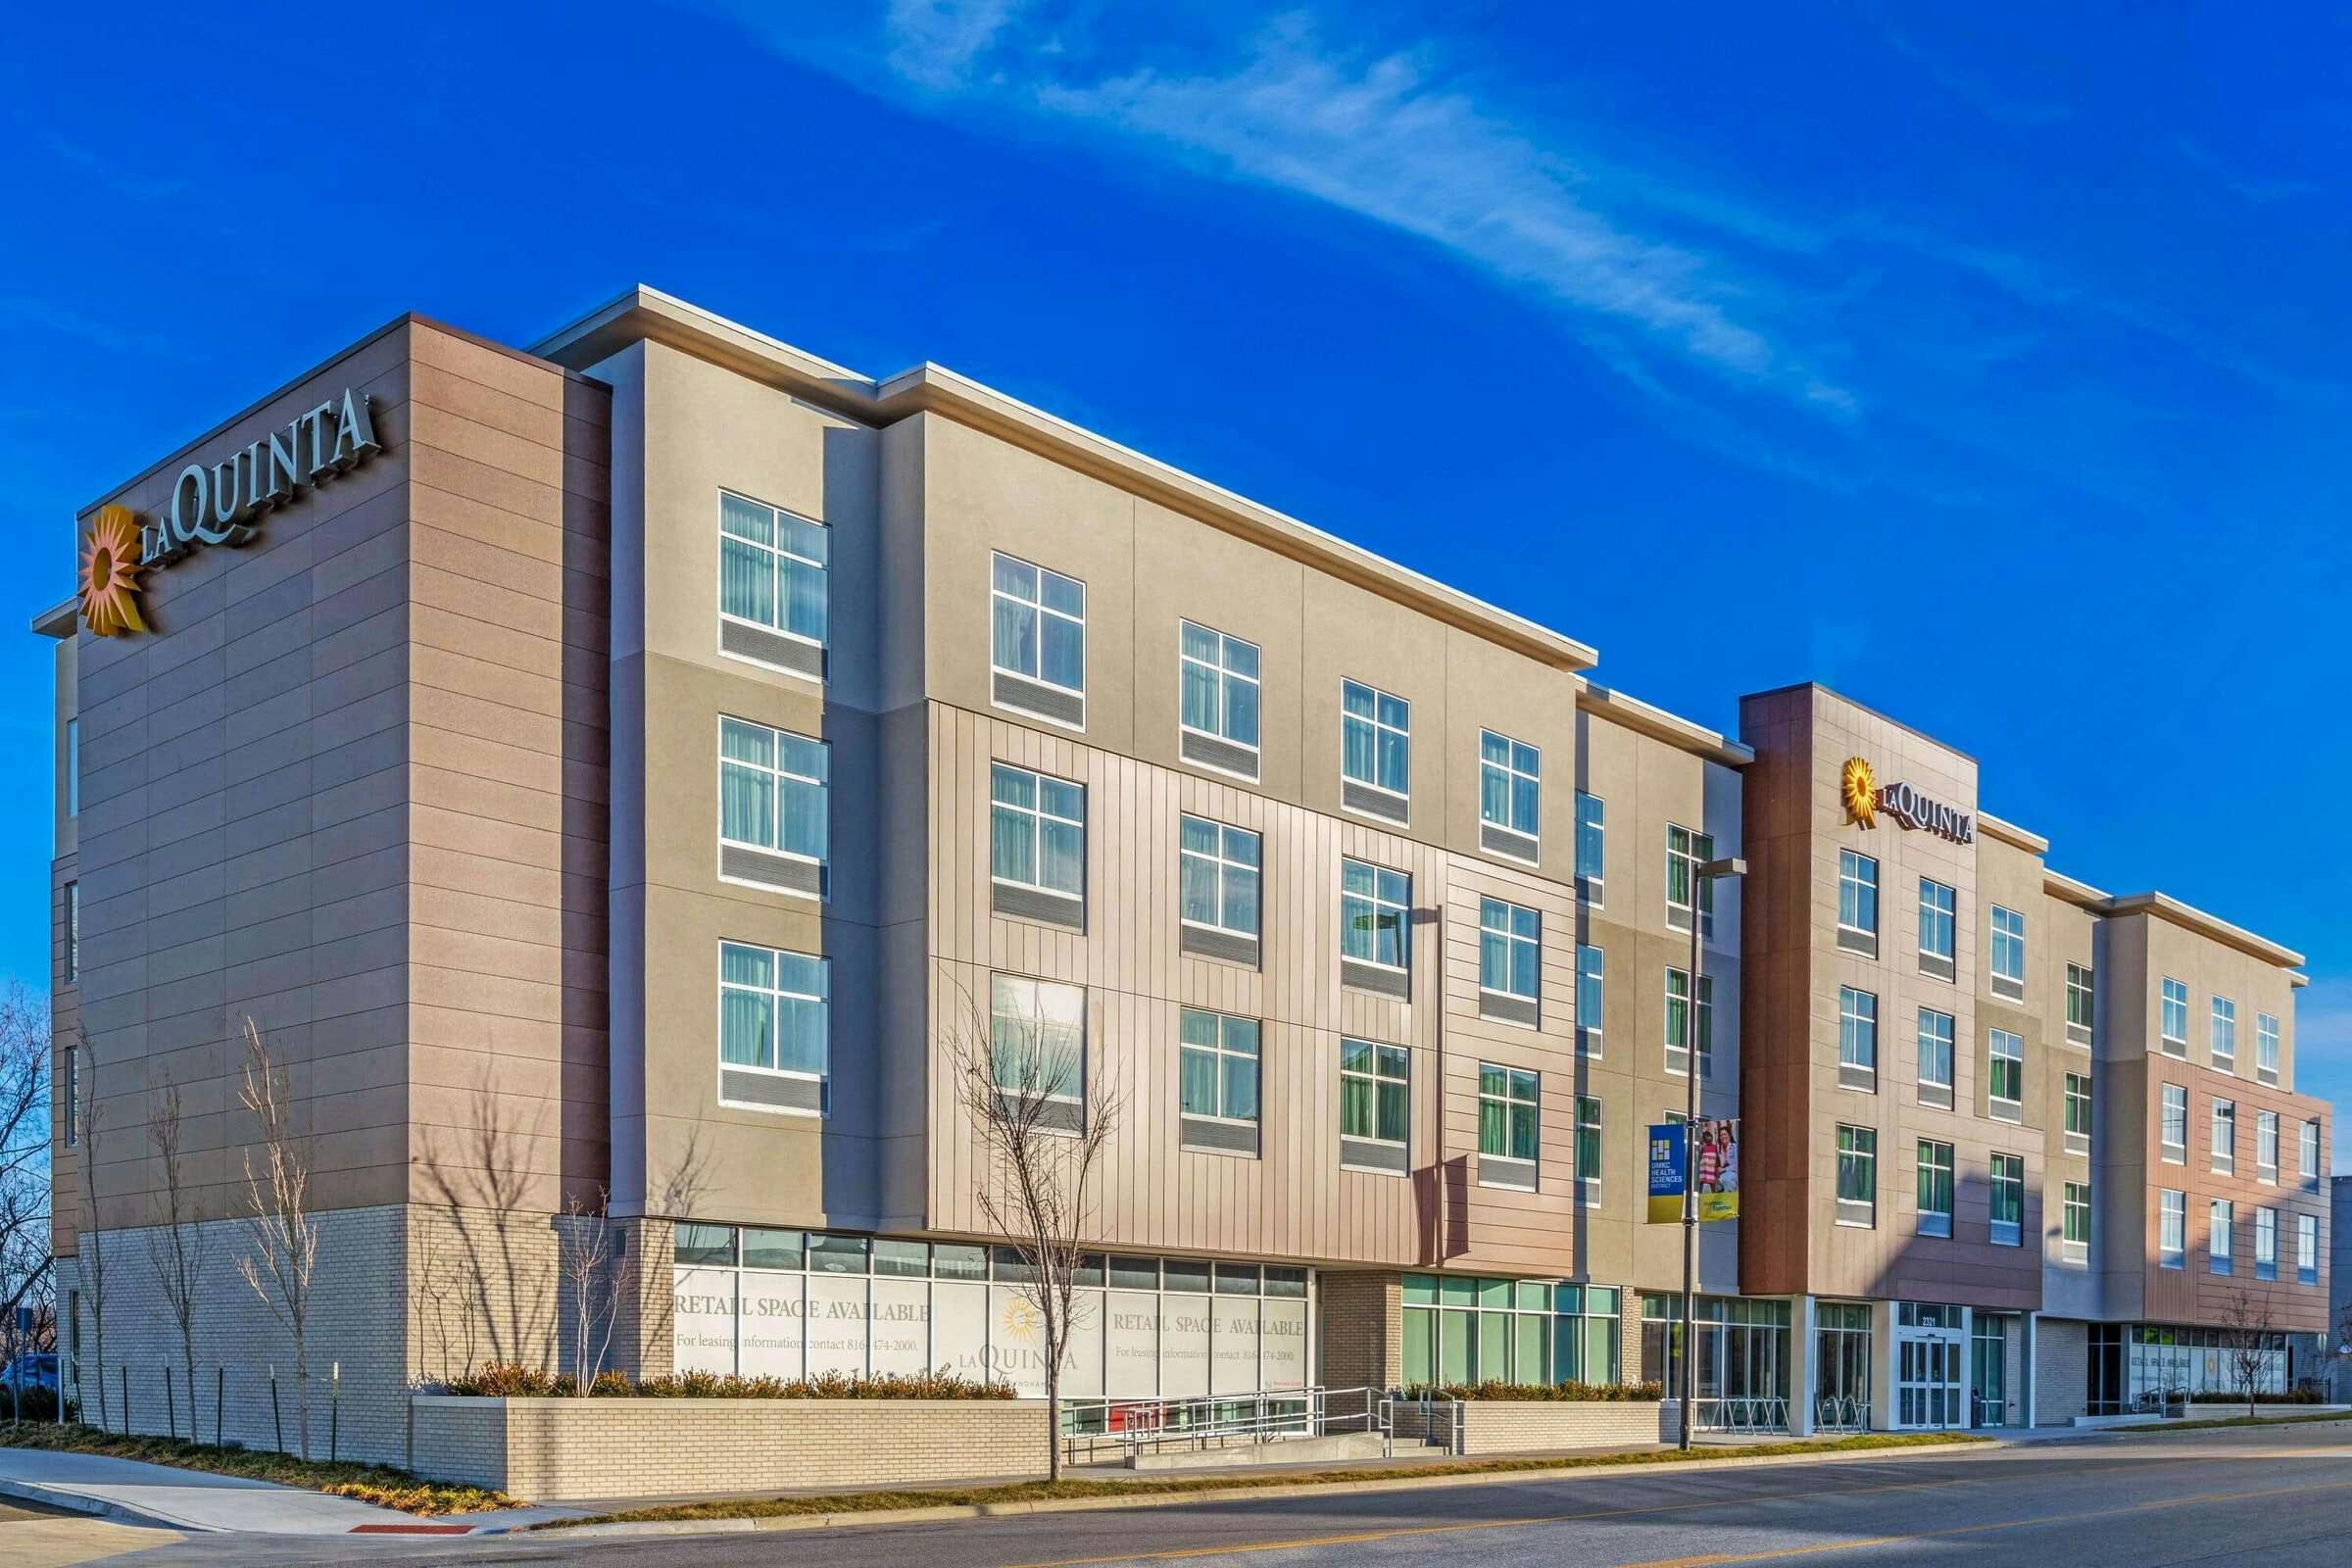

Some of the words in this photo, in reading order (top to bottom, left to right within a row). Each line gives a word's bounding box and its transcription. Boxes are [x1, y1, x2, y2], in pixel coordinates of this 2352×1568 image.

[141, 516, 173, 565] LA
[172, 387, 381, 545] QUINTA
[1883, 788, 1898, 811] LA
[1898, 780, 1976, 843] QUINTA
[673, 1295, 753, 1315] RETAIL
[758, 1298, 819, 1318] SPACE
[826, 1300, 930, 1322] AVAILABLE
[1113, 1314, 1170, 1332] RETAIL
[1176, 1317, 1223, 1333] SPACE
[1230, 1319, 1303, 1336] AVAILABLE
[676, 1333, 696, 1347] For
[699, 1333, 737, 1351] leasing
[741, 1335, 805, 1348] nformation
[808, 1338, 844, 1350] contact
[847, 1339, 918, 1351] 816474-2000.
[959, 1354, 977, 1368] LA
[978, 1345, 1077, 1374] QUINA
